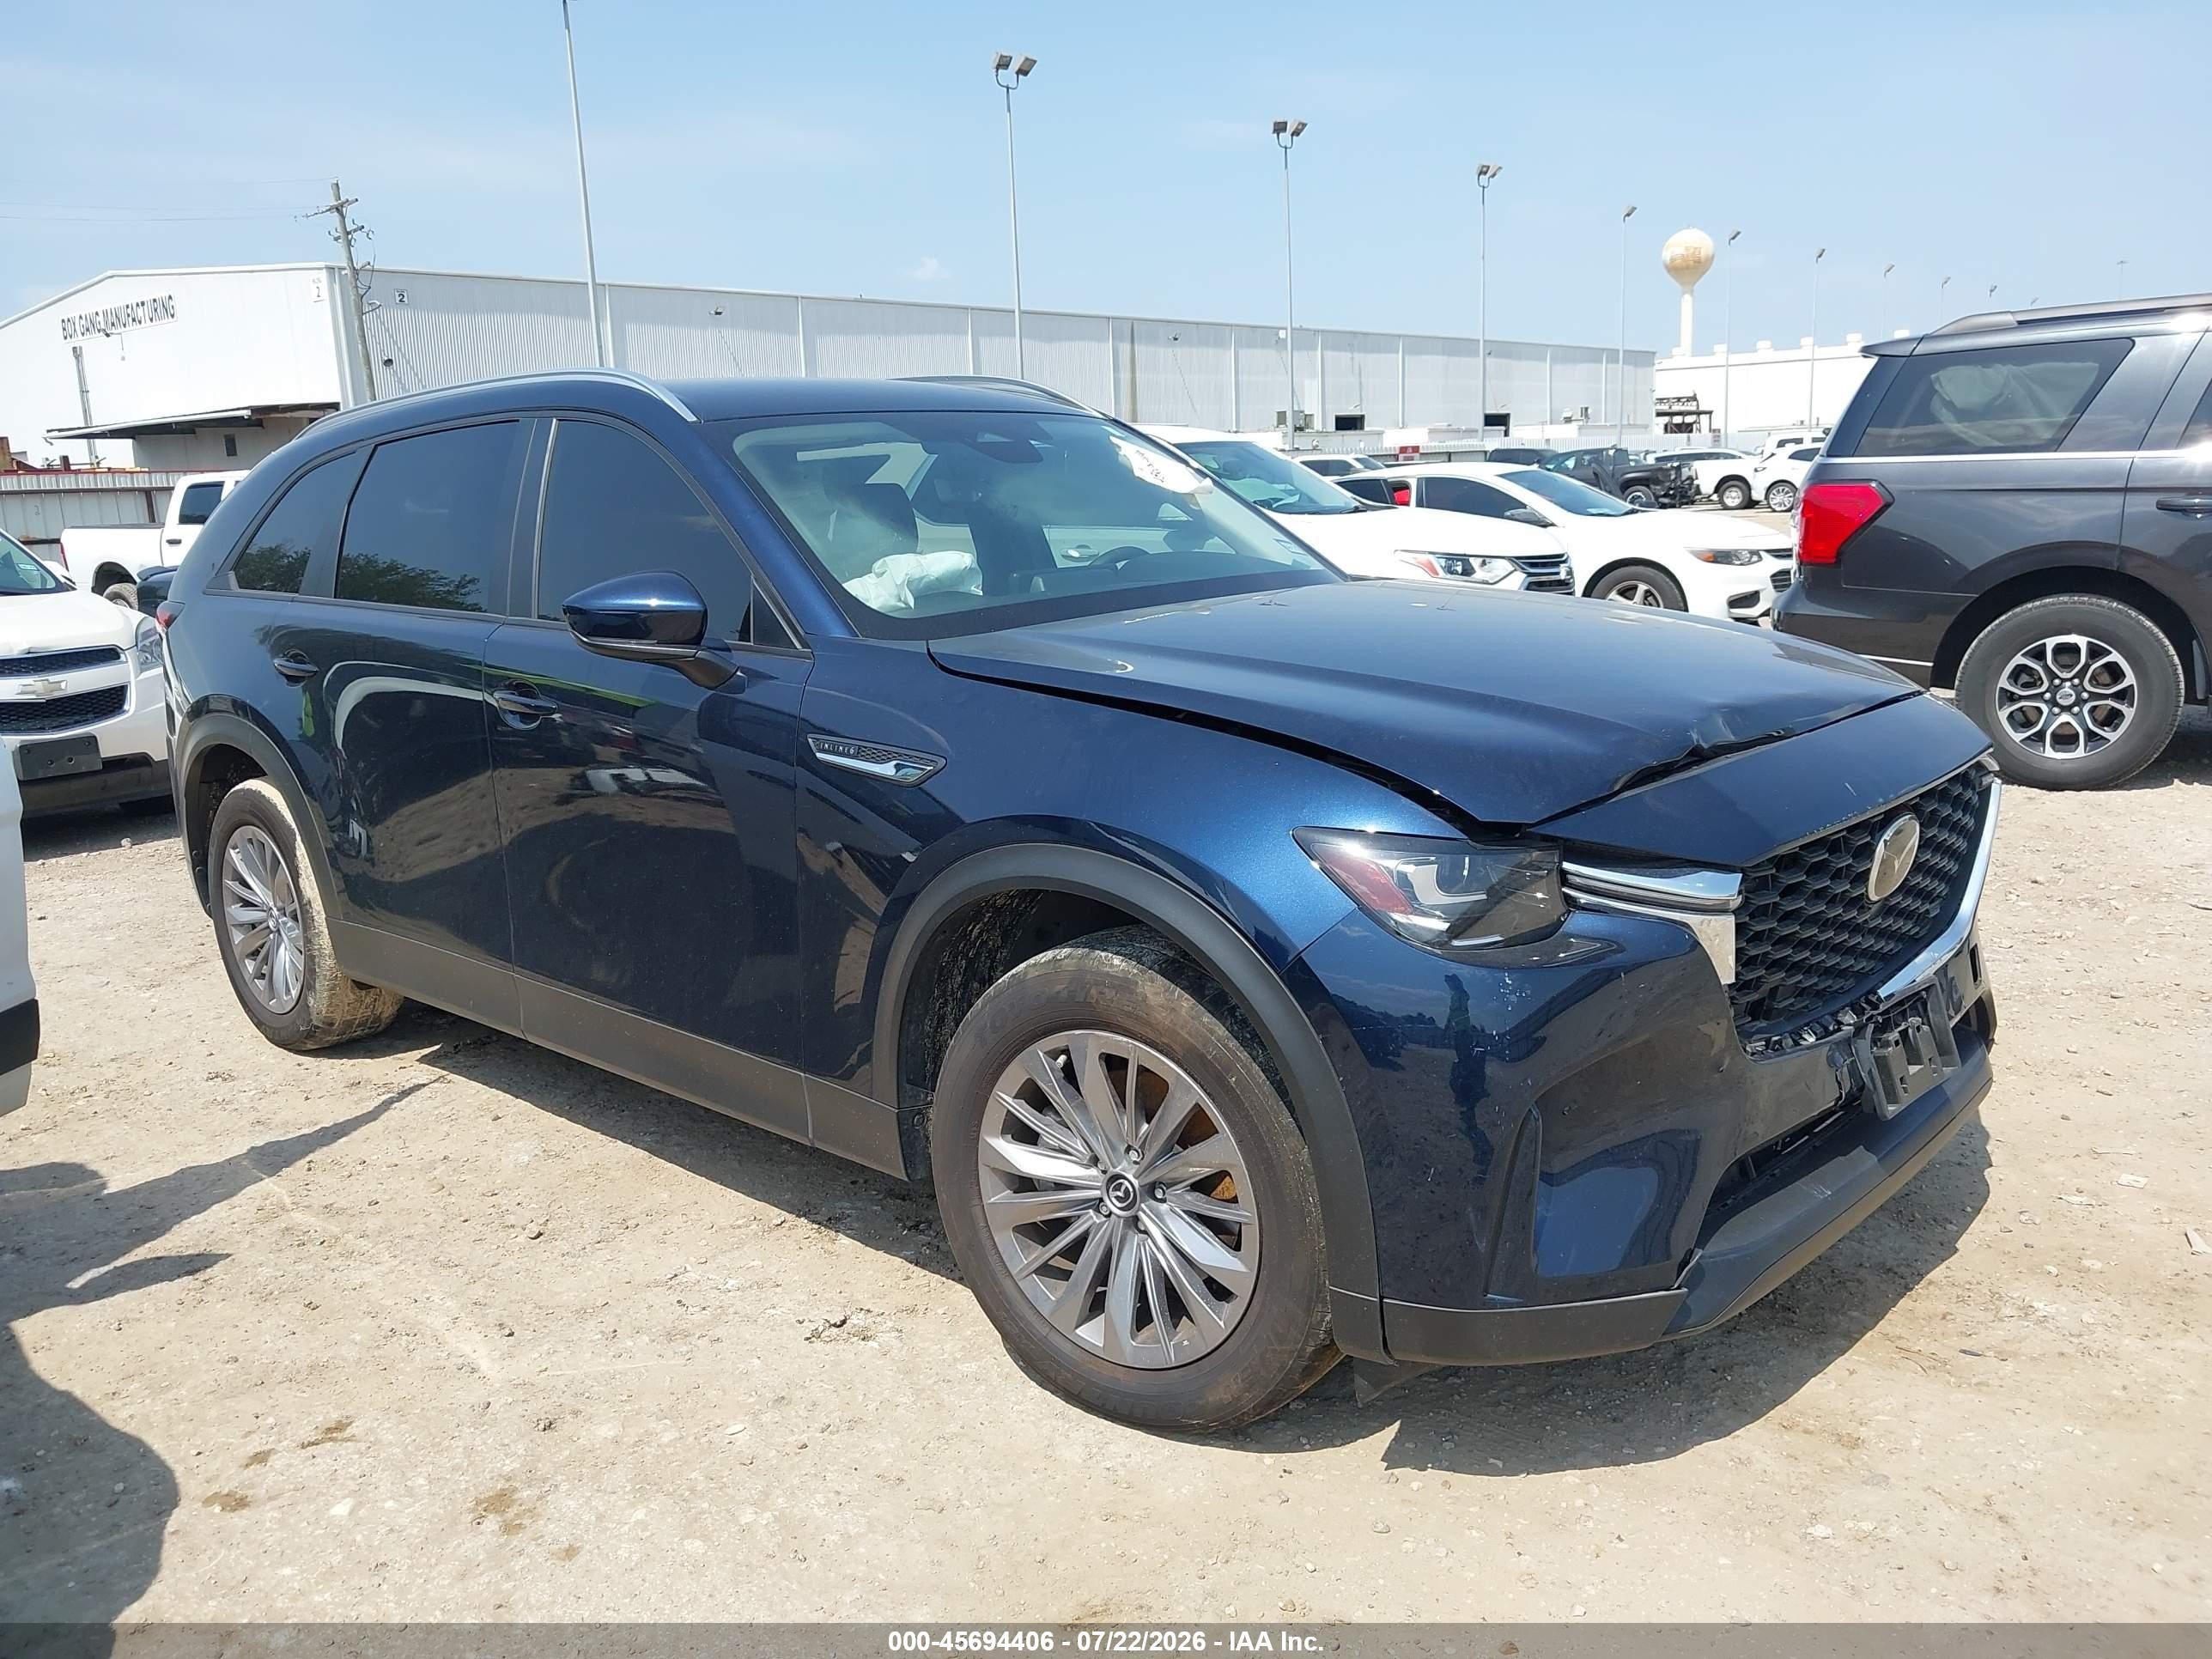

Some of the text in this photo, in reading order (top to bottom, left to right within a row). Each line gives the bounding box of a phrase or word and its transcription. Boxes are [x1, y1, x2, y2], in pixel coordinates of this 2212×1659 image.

[398, 293, 406, 303] 2
[61, 294, 175, 340] BOX GANG MANUFACTURING
